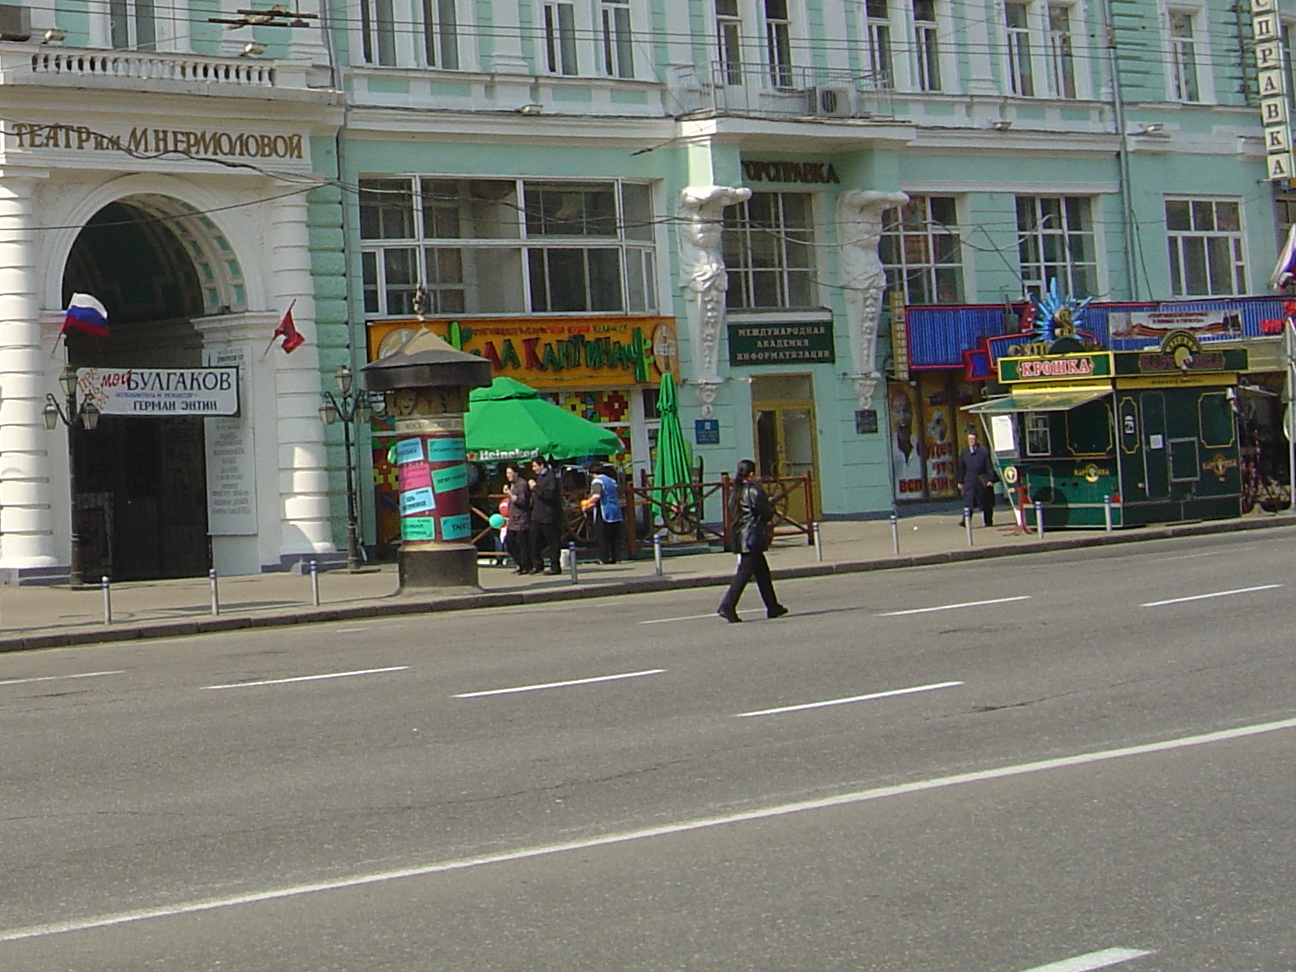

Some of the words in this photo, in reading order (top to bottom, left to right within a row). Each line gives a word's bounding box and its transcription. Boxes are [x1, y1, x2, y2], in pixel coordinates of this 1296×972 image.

[12, 123, 92, 149] ТЕАТР
[738, 326, 825, 337] МЕЖДУНАРОДНАЯ
[756, 338, 810, 349] АКАДЕМИЯ
[736, 350, 830, 361] ИНФОРМАТИЗАЦИИ
[1021, 358, 1091, 377] КРОШКА
[127, 371, 231, 391] БУЛГАКОВ
[133, 400, 176, 411] ГЕРМАН
[181, 400, 217, 411] ЭНТИН
